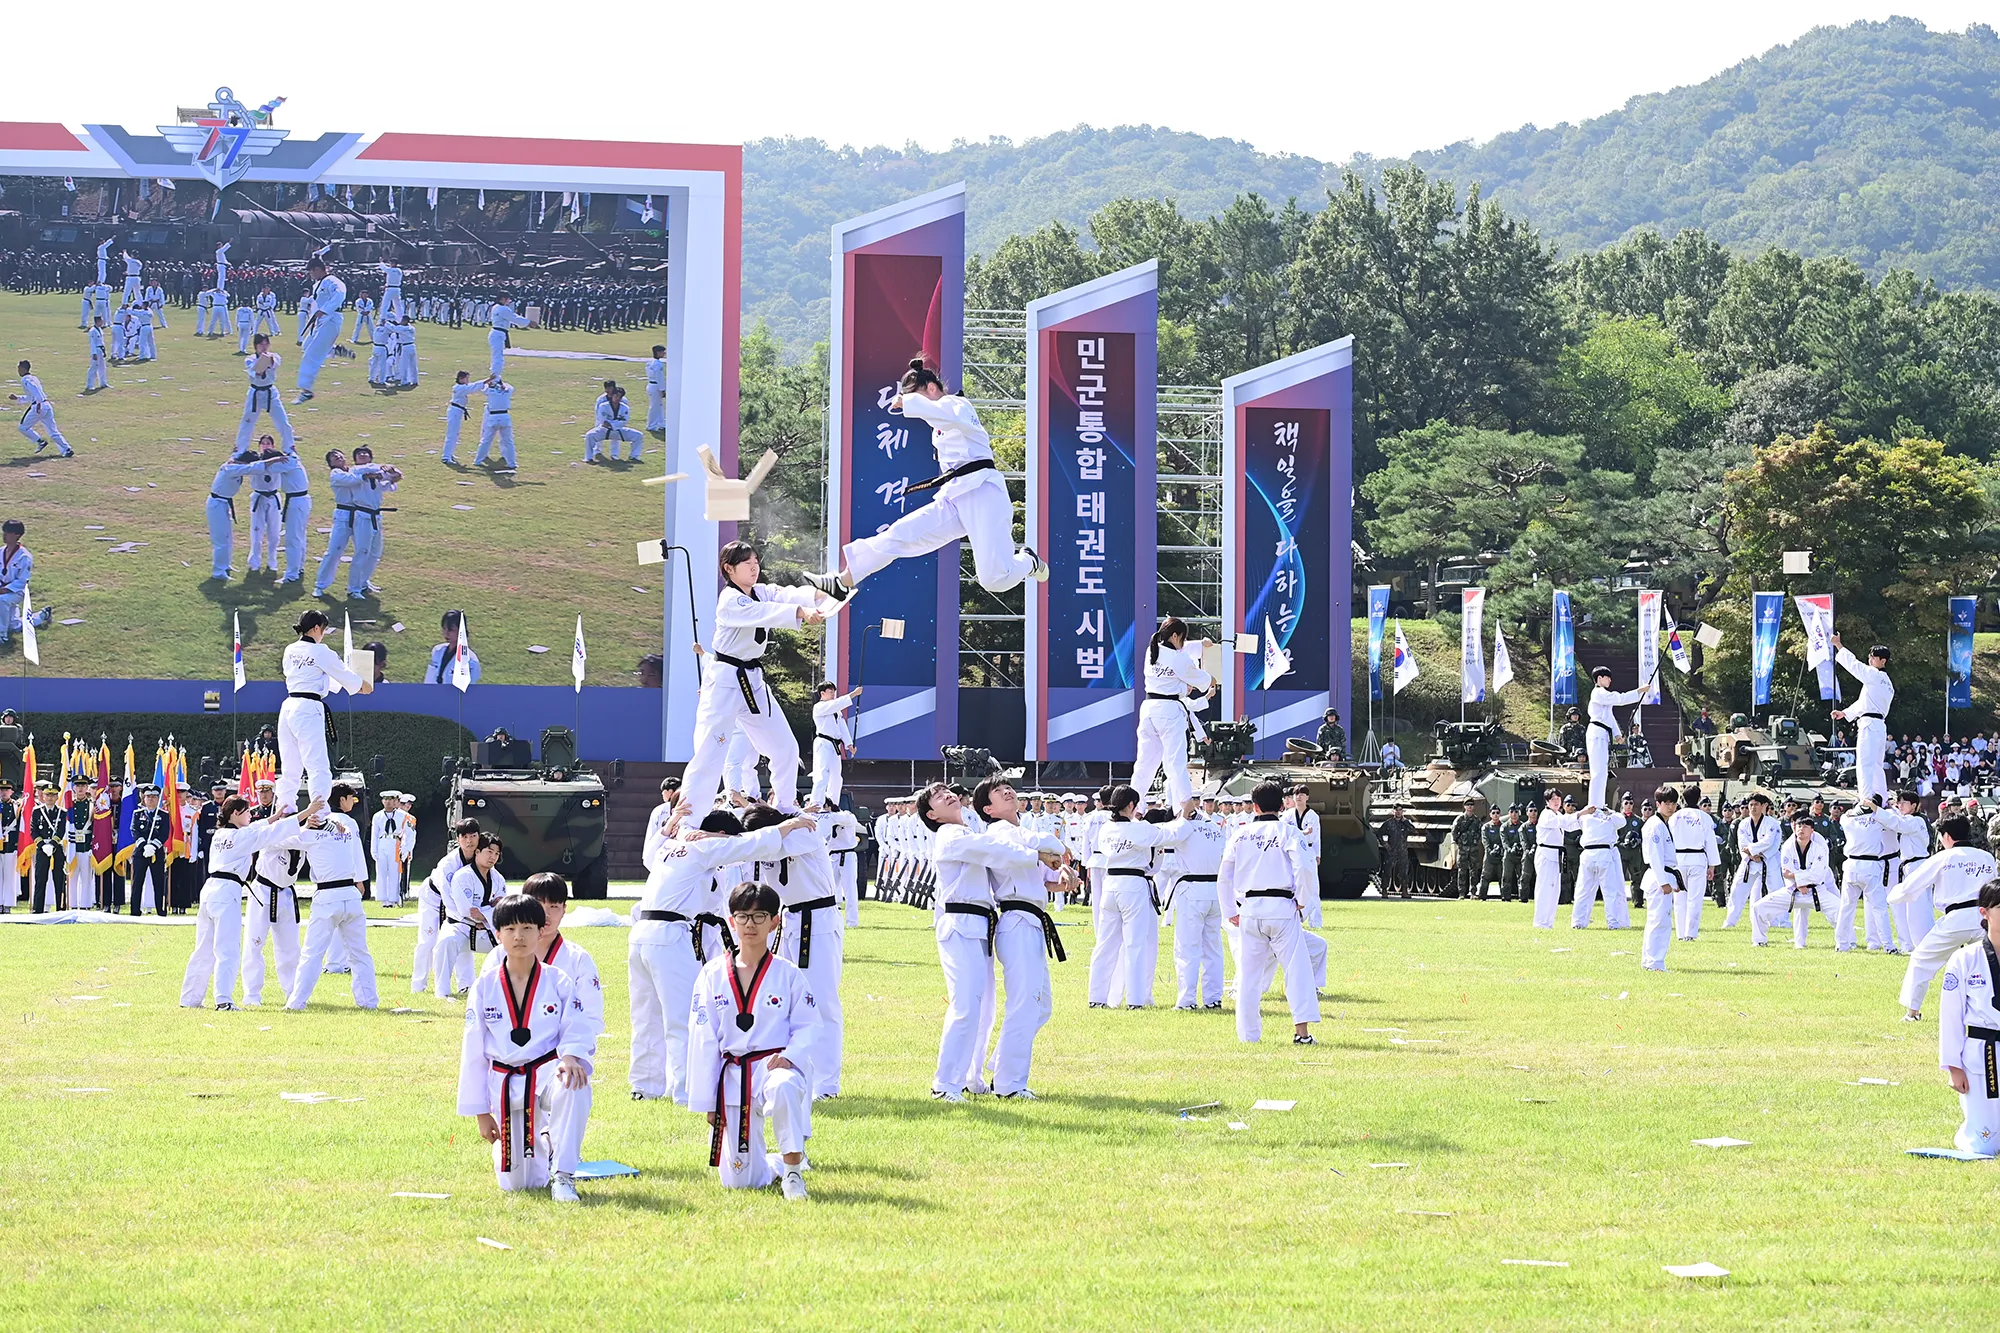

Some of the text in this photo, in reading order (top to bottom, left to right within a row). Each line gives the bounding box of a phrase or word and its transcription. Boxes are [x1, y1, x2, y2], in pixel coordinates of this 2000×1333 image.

[1075, 337, 1107, 679] 민군통합 태권도 시범
[1274, 536, 1299, 633] 다하는
